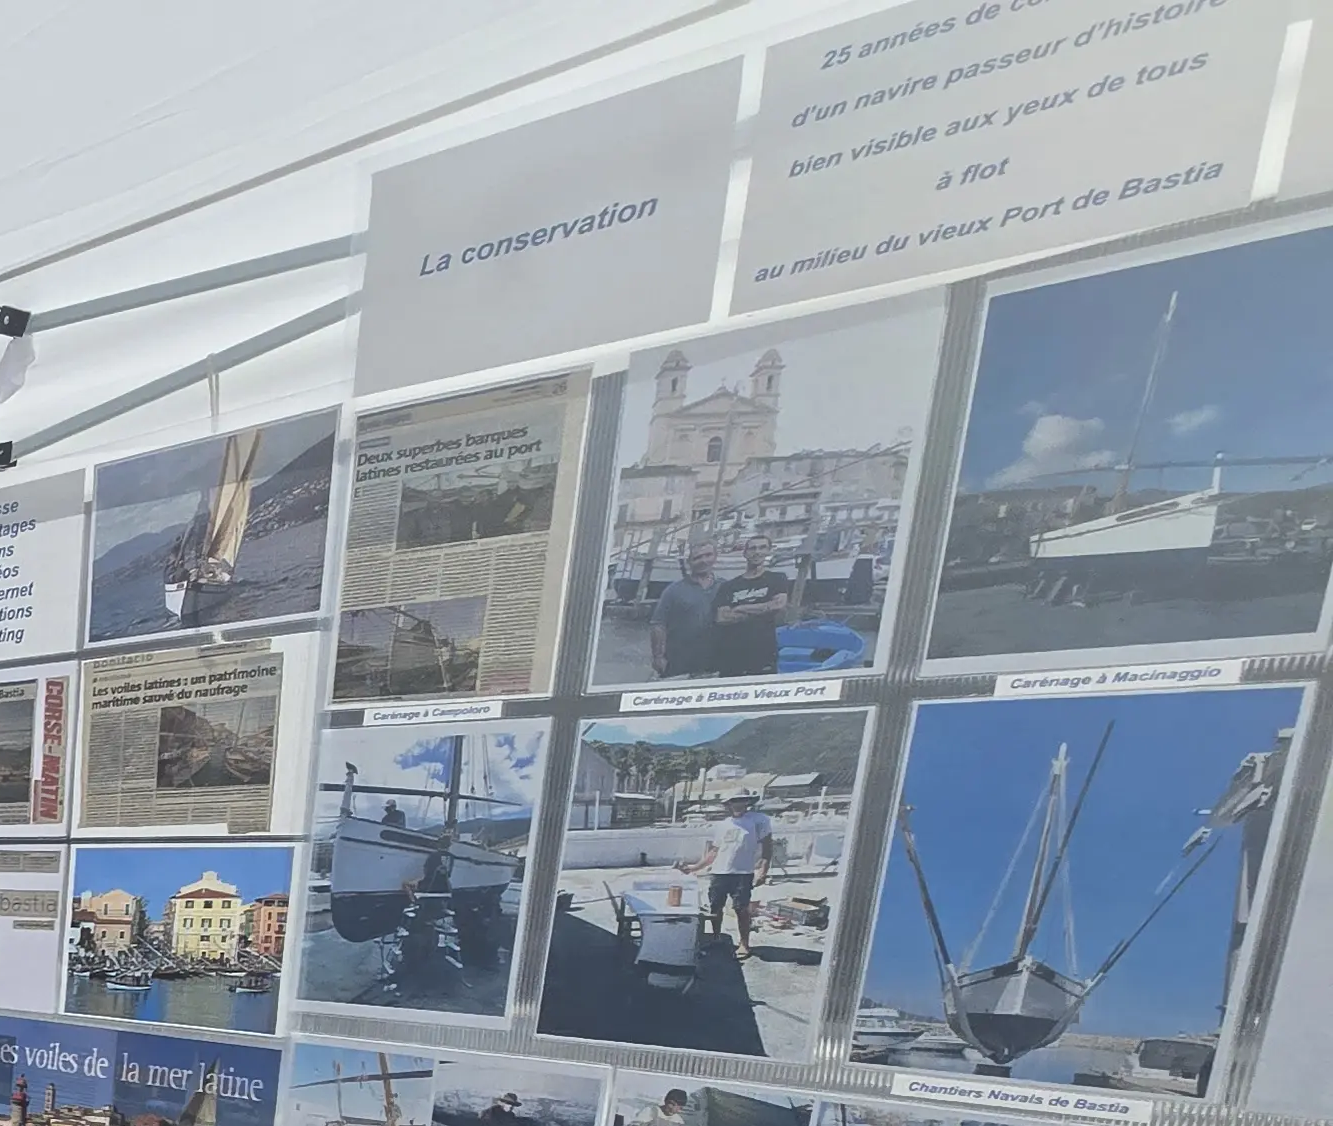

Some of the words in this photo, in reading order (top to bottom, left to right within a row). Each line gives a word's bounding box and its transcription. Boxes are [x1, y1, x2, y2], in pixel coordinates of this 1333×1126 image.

[820, 50, 851, 71] 25
[857, 16, 955, 59] années
[965, 2, 999, 26] de
[791, 102, 847, 129] d'un
[853, 74, 938, 112] navire
[942, 38, 1072, 90] passeur
[788, 151, 842, 178] bien
[850, 124, 938, 159] visible
[943, 110, 998, 137] aux
[1002, 87, 1077, 127] yeux
[1086, 71, 1125, 99] de
[1135, 50, 1210, 87] tous
[935, 171, 952, 191] à
[959, 157, 1010, 186] flot
[419, 253, 451, 276] La
[461, 198, 659, 264] conservation
[754, 263, 785, 284] au
[790, 244, 867, 276] milieu
[874, 234, 909, 255] du
[918, 214, 992, 246] vieux
[1000, 197, 1065, 228] Port
[1071, 188, 1110, 211] de
[1118, 159, 1225, 202] Bastia
[356, 465, 401, 482] latines
[404, 451, 480, 475] restaurées
[484, 449, 504, 460] au
[507, 439, 543, 459] port
[357, 453, 393, 467] Deux
[396, 438, 462, 461] superbes
[465, 426, 529, 449] barques
[92, 695, 140, 709] maritime
[176, 688, 192, 699] du
[195, 684, 248, 699] naufrage
[93, 687, 108, 697] Les
[111, 682, 141, 694] voiles
[144, 677, 181, 690] latines
[190, 675, 206, 685] un
[209, 665, 277, 685] patrimoine
[633, 694, 692, 706] Carénage
[707, 690, 748, 701] Bastia
[754, 688, 790, 698] Vieux
[794, 685, 826, 698] Port
[1010, 676, 1091, 690] Carénage
[1096, 674, 1106, 684] à
[1112, 666, 1221, 683] Macinaggio
[39, 680, 64, 820] CORSE-MATIN
[0, 893, 57, 912] bastia
[25, 1042, 78, 1074] voiles
[84, 1048, 109, 1079] de
[120, 1053, 140, 1084] la
[147, 1065, 193, 1091] mer
[196, 1062, 264, 1101] latine
[909, 1081, 983, 1099] Chantiers
[988, 1090, 1044, 1105] Navals
[1049, 1096, 1069, 1107] de
[1074, 1098, 1130, 1114] Bastia
